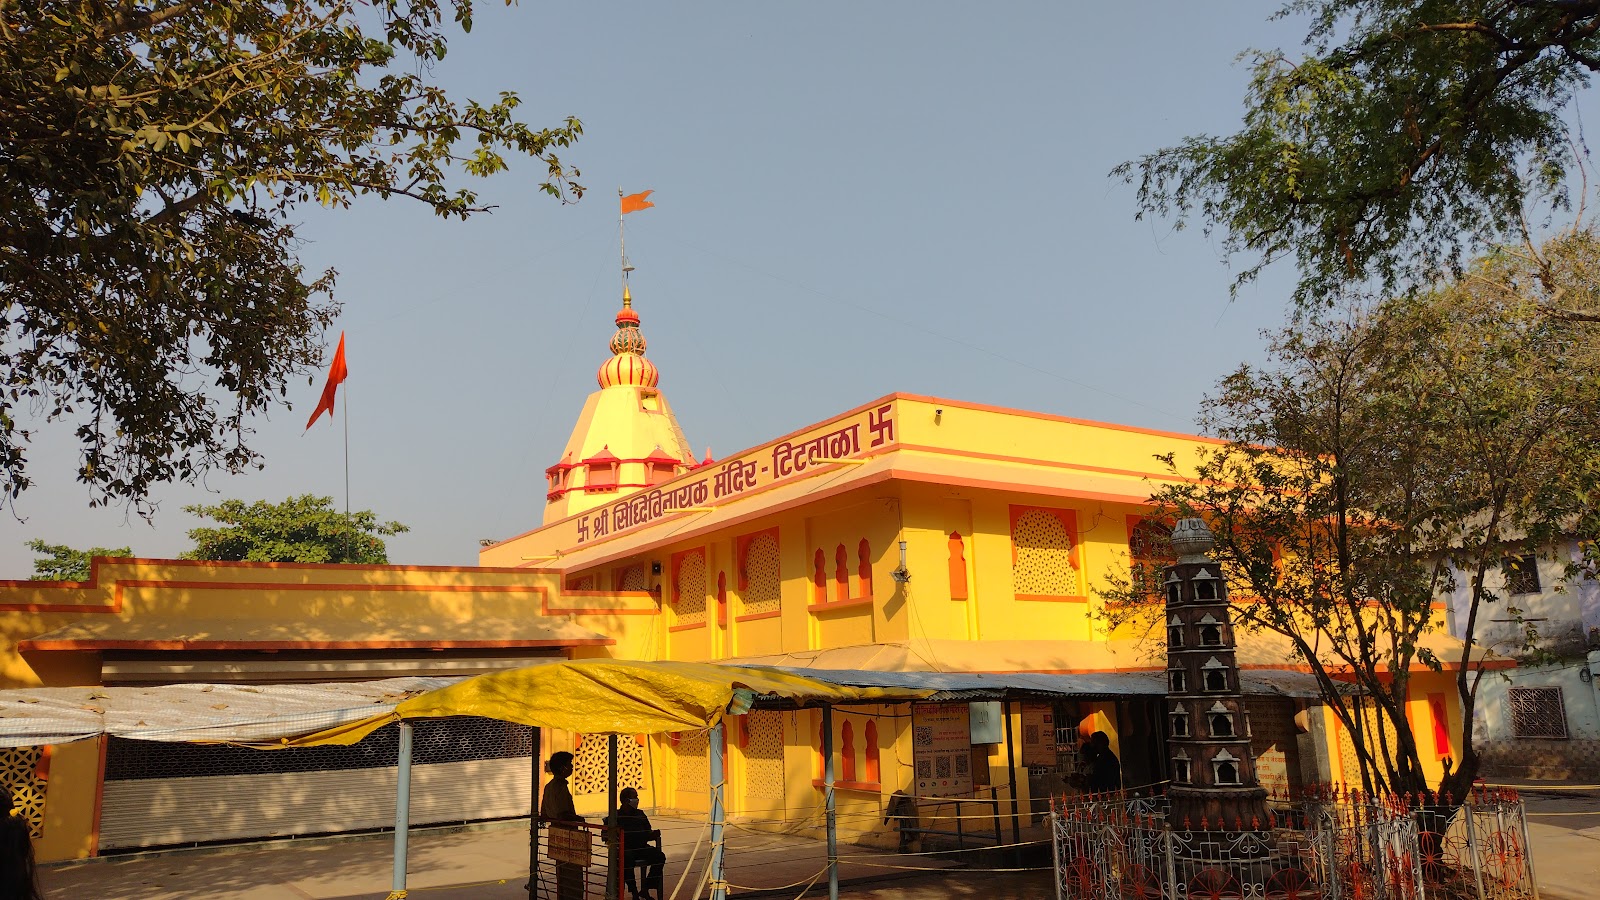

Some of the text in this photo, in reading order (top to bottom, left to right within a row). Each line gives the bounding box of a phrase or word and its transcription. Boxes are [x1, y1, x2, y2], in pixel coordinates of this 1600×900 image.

[594, 508, 609, 538] श्री
[713, 459, 758, 499] मंदिर
[772, 423, 861, 479] टिटवाळा
